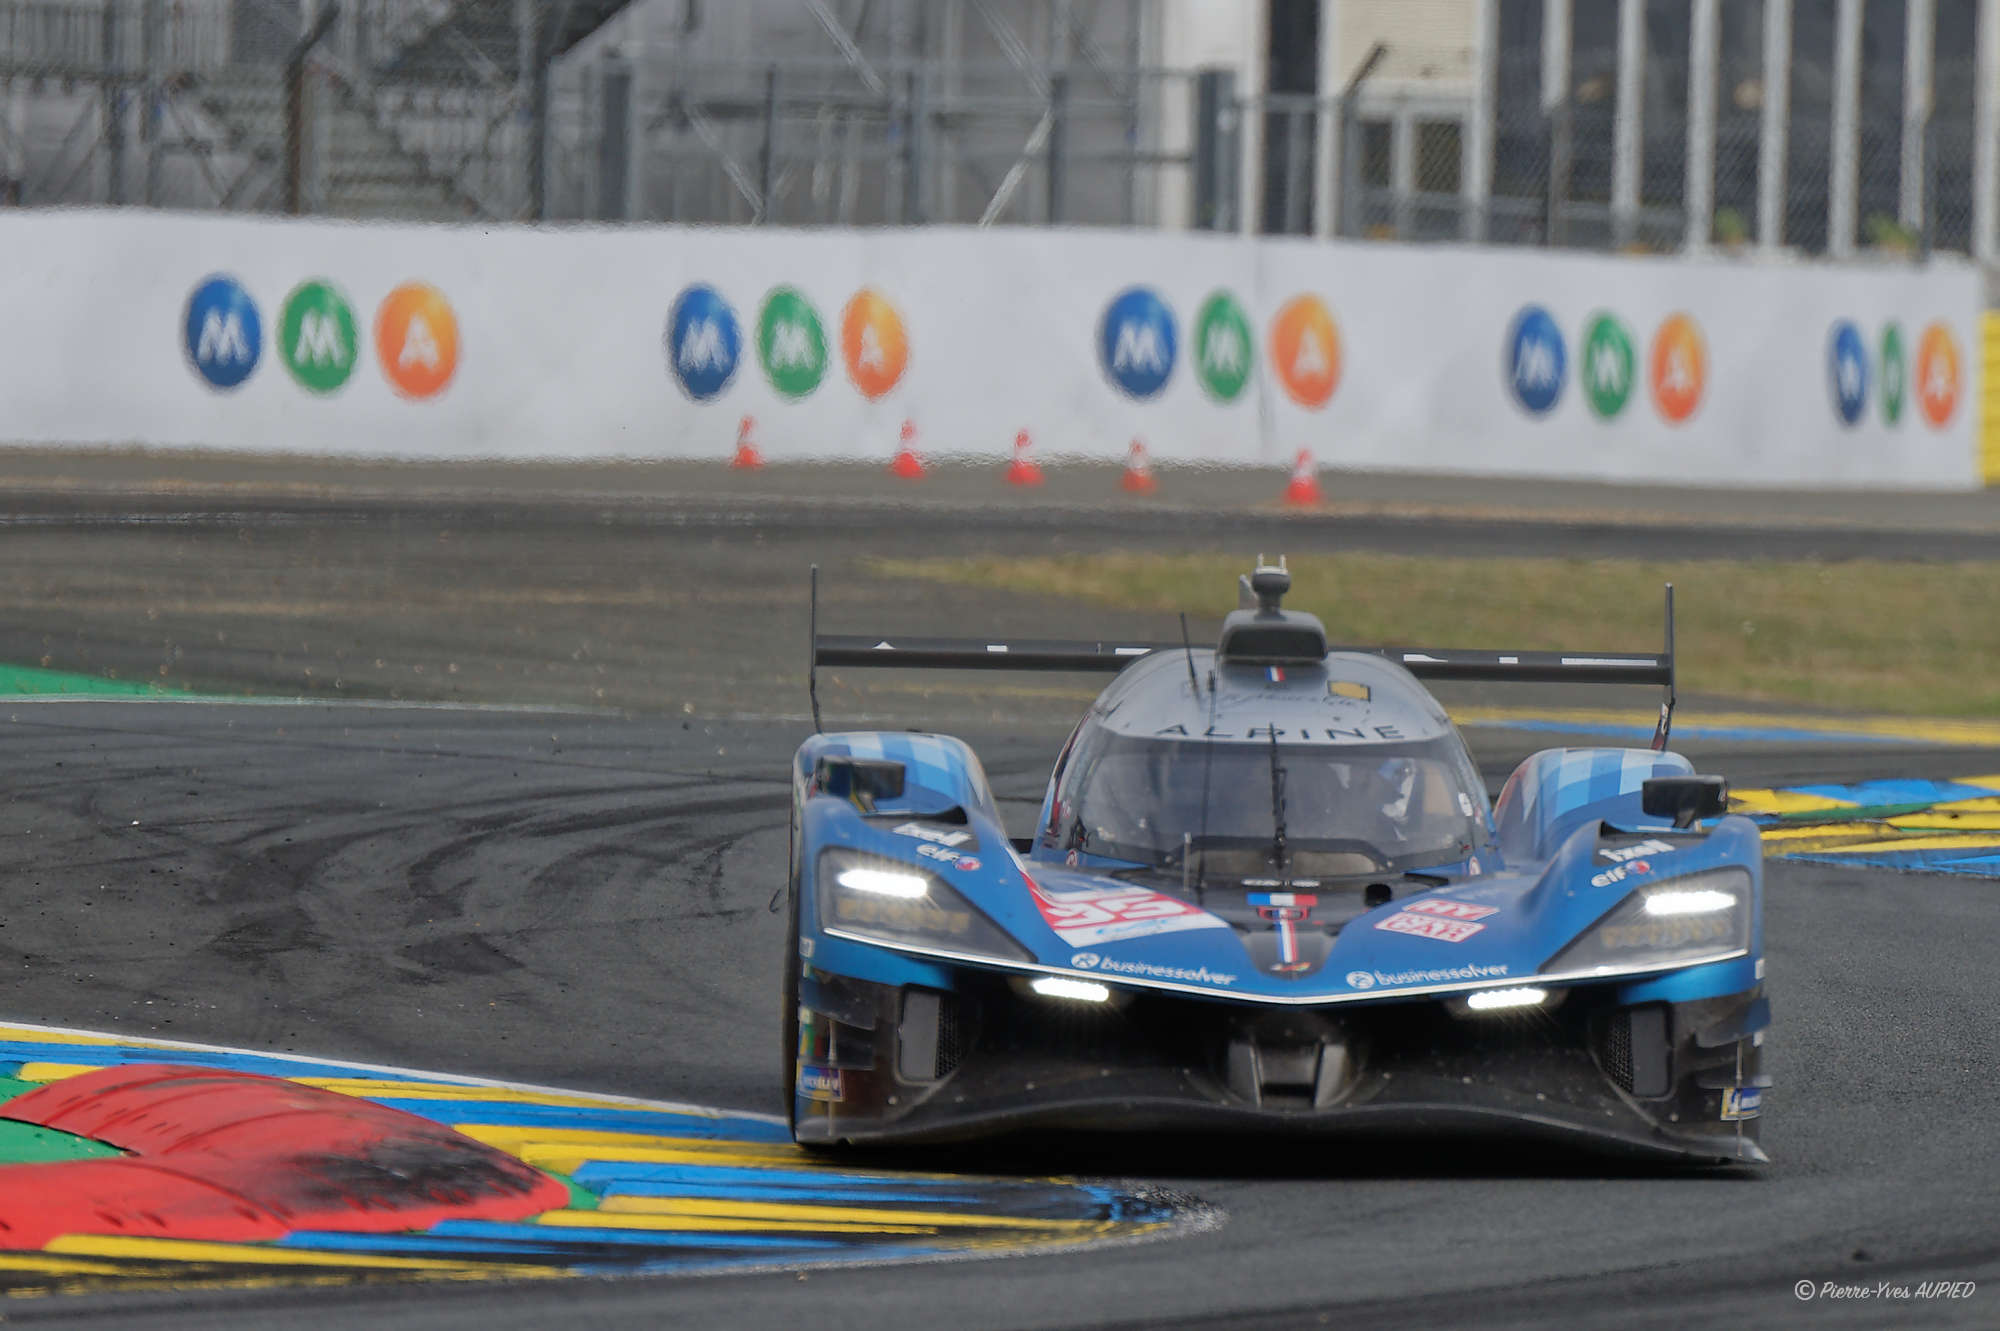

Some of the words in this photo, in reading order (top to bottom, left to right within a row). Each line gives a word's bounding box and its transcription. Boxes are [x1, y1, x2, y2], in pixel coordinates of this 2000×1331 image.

[193, 302, 446, 377] MMA
[673, 309, 890, 378] MMA
[1108, 315, 1333, 386] MMA
[1154, 723, 1405, 741] ALPINE
[1100, 955, 1238, 986] businessolver
[1374, 963, 1508, 986] businessolver
